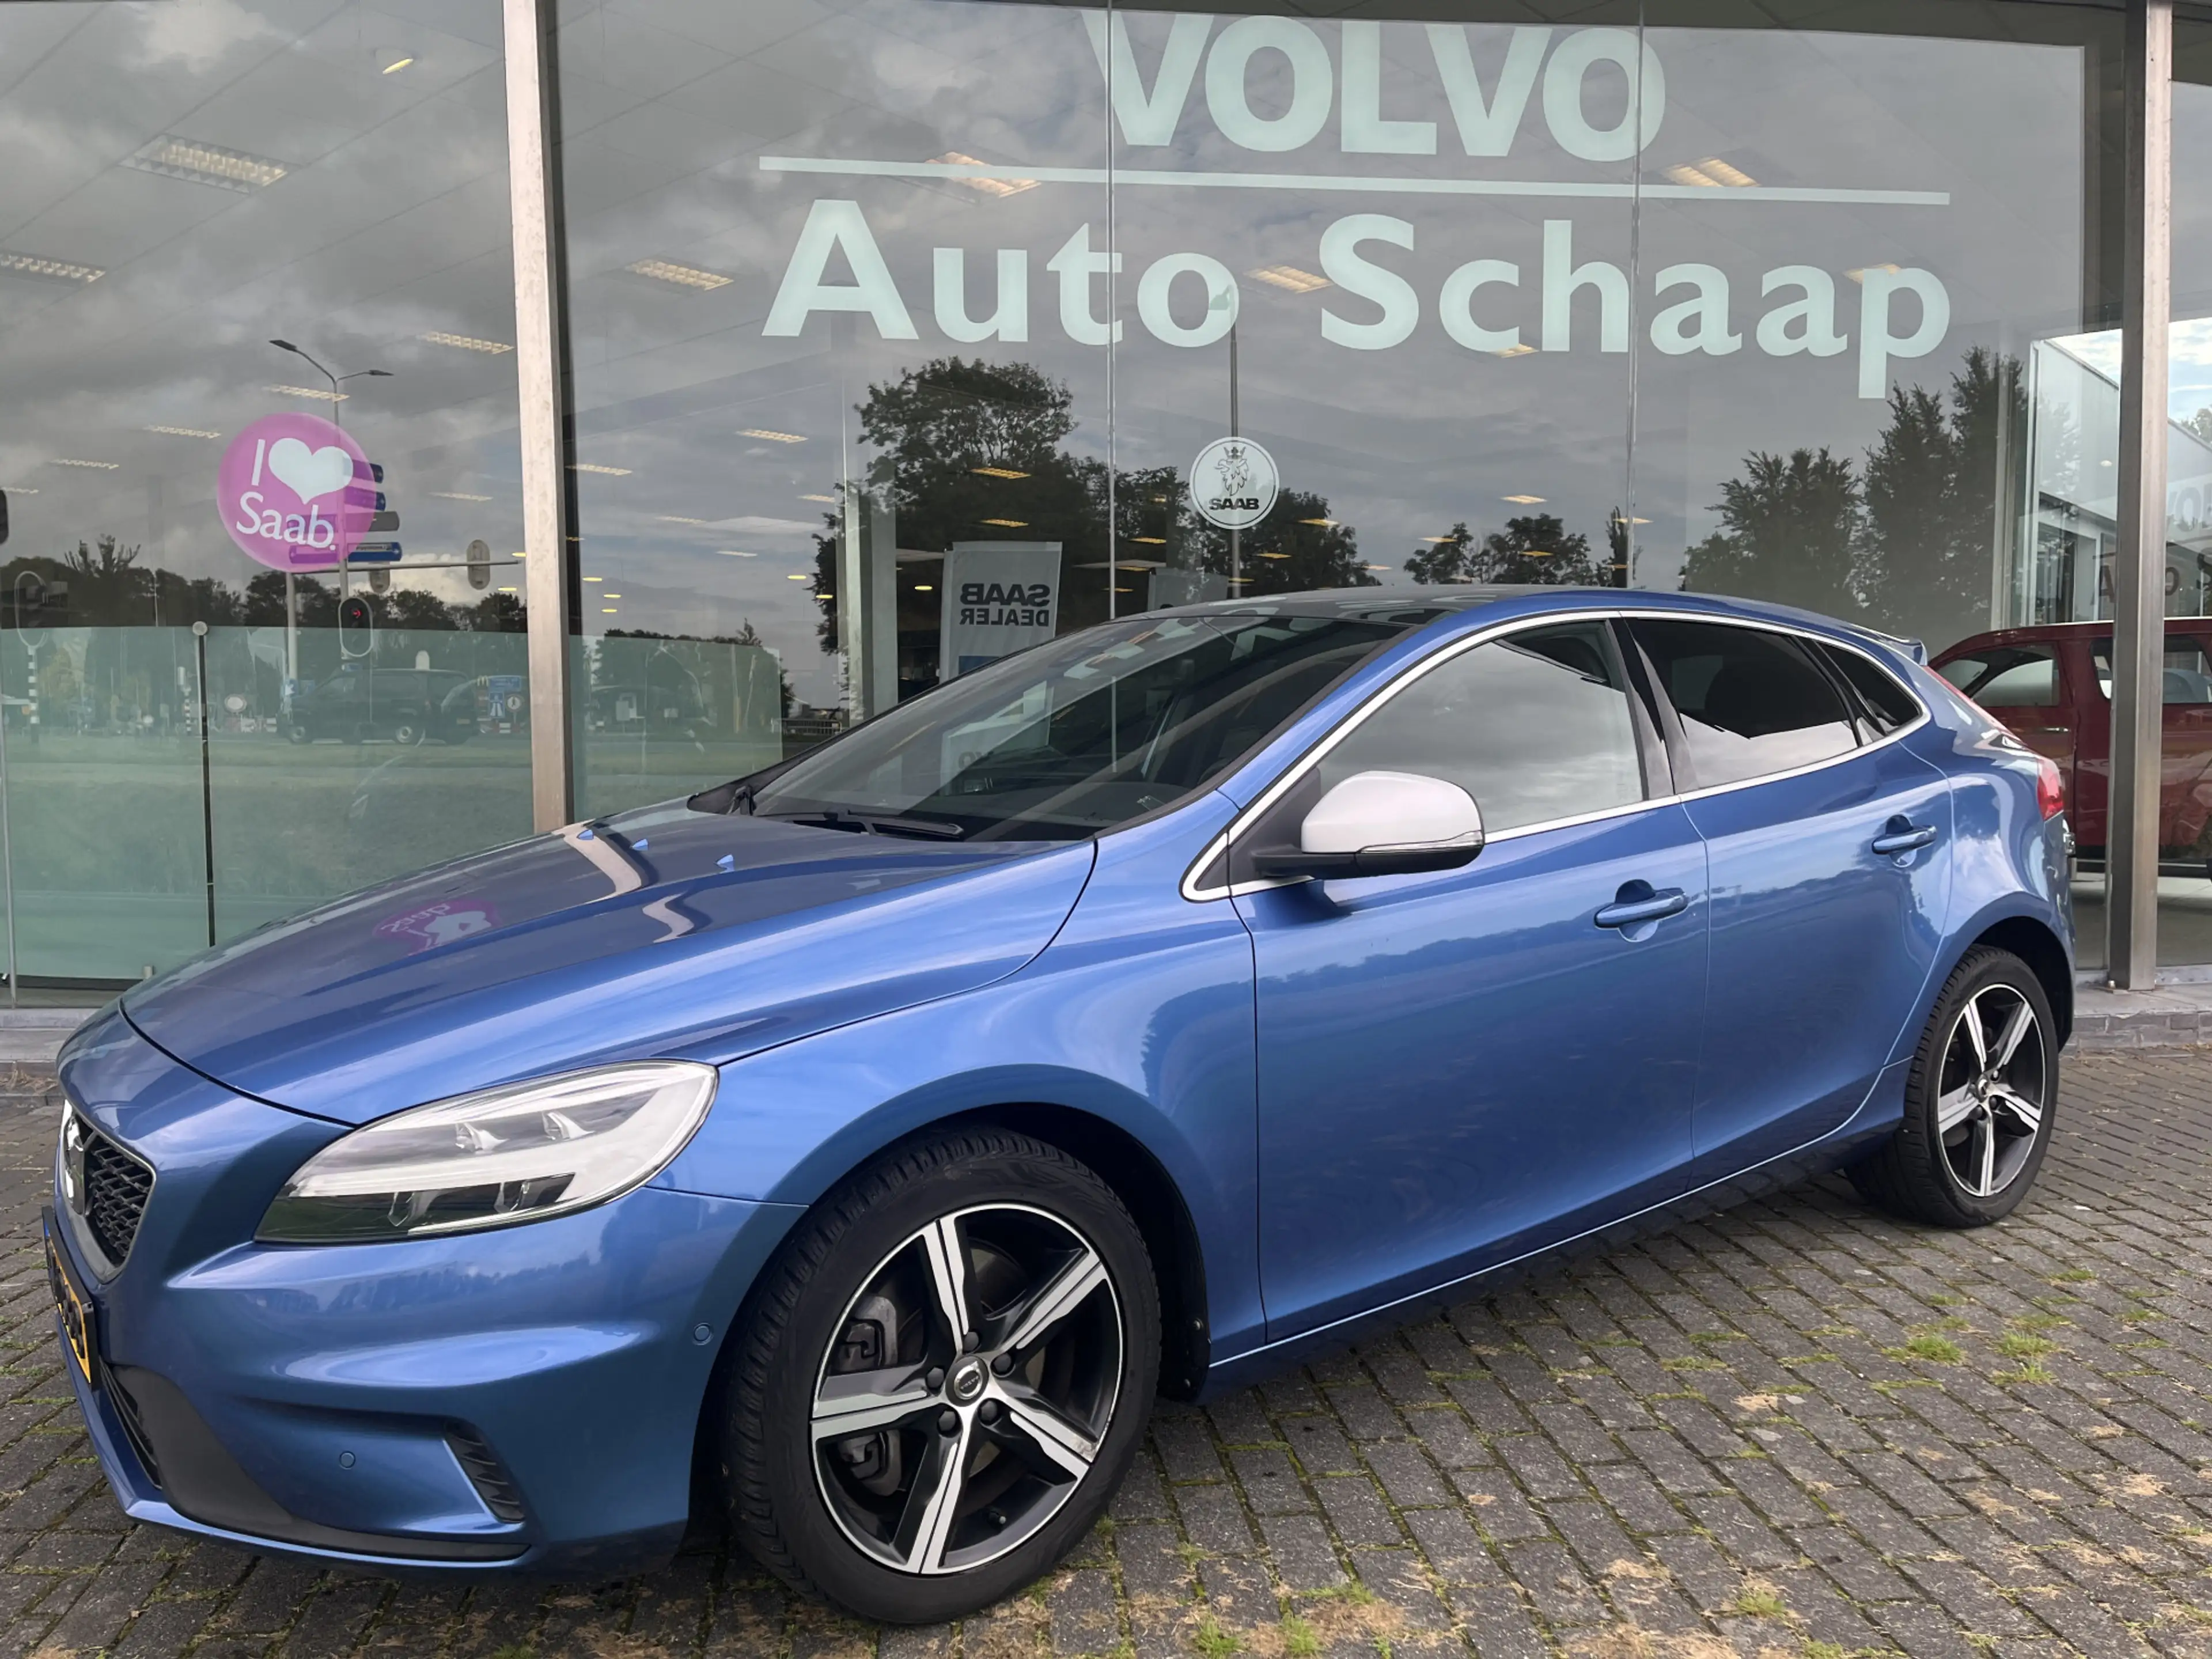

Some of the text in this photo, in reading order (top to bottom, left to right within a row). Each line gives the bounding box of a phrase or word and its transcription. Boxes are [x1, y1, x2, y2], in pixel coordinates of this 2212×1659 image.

[1081, 10, 1666, 162] VOLVO
[761, 199, 1950, 399] Auto Schaap
[251, 438, 266, 486] I
[1209, 498, 1259, 510] SAAB
